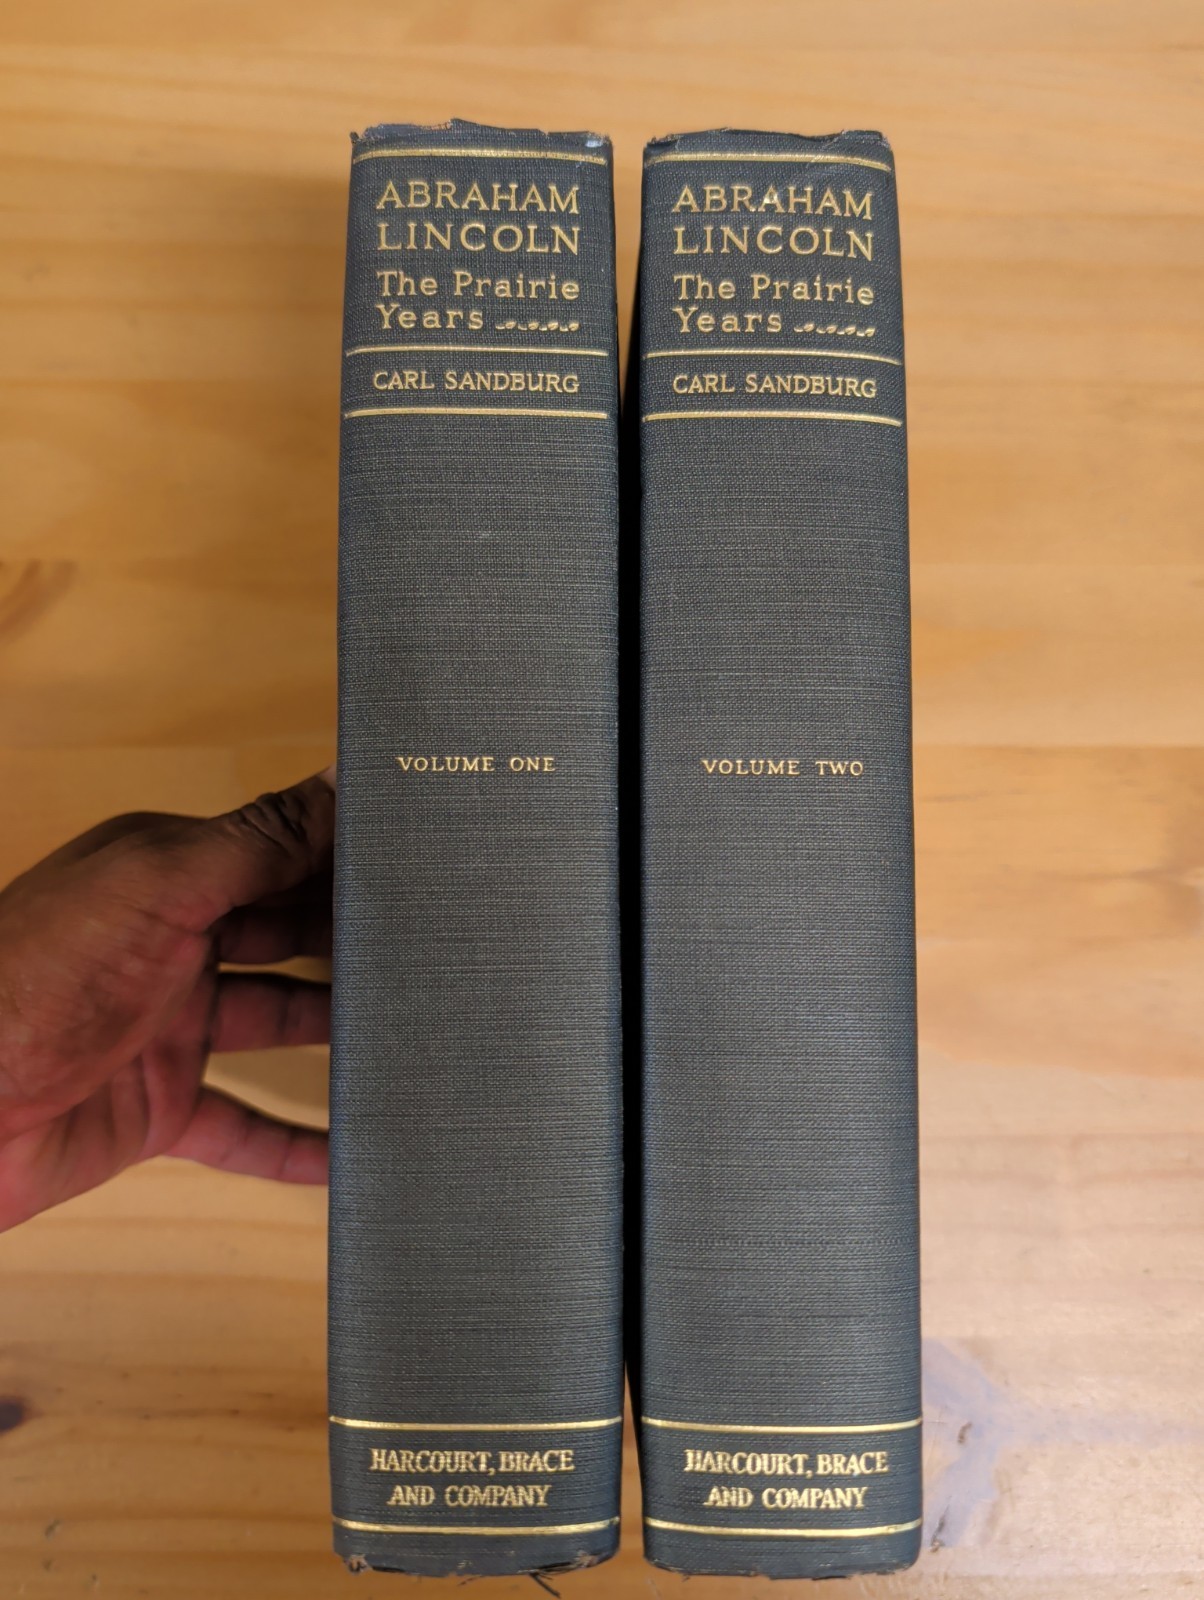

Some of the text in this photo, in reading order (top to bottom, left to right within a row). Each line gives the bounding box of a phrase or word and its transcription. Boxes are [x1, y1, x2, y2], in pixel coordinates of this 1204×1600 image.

[376, 180, 580, 214] ABRAHAM
[672, 185, 873, 220] ABRAHAM
[377, 222, 580, 255] LINCOLN
[673, 226, 873, 261] LINCOLN
[376, 271, 580, 300] The Prairie
[673, 274, 874, 306] The Prairie
[376, 303, 484, 330] Years
[672, 306, 782, 333] Years
[373, 371, 579, 393] CARL SANDBURG
[673, 374, 877, 398] CARL SANDBURG
[396, 756, 556, 772] VOLUME ONE
[702, 759, 864, 776] VOLUME TWO
[369, 1448, 575, 1476] HARCOURT, BRACE
[684, 1449, 889, 1478] HARCOURT, BRACE
[387, 1485, 552, 1507] AND COMPANY
[704, 1486, 868, 1509] AND COMPANY
